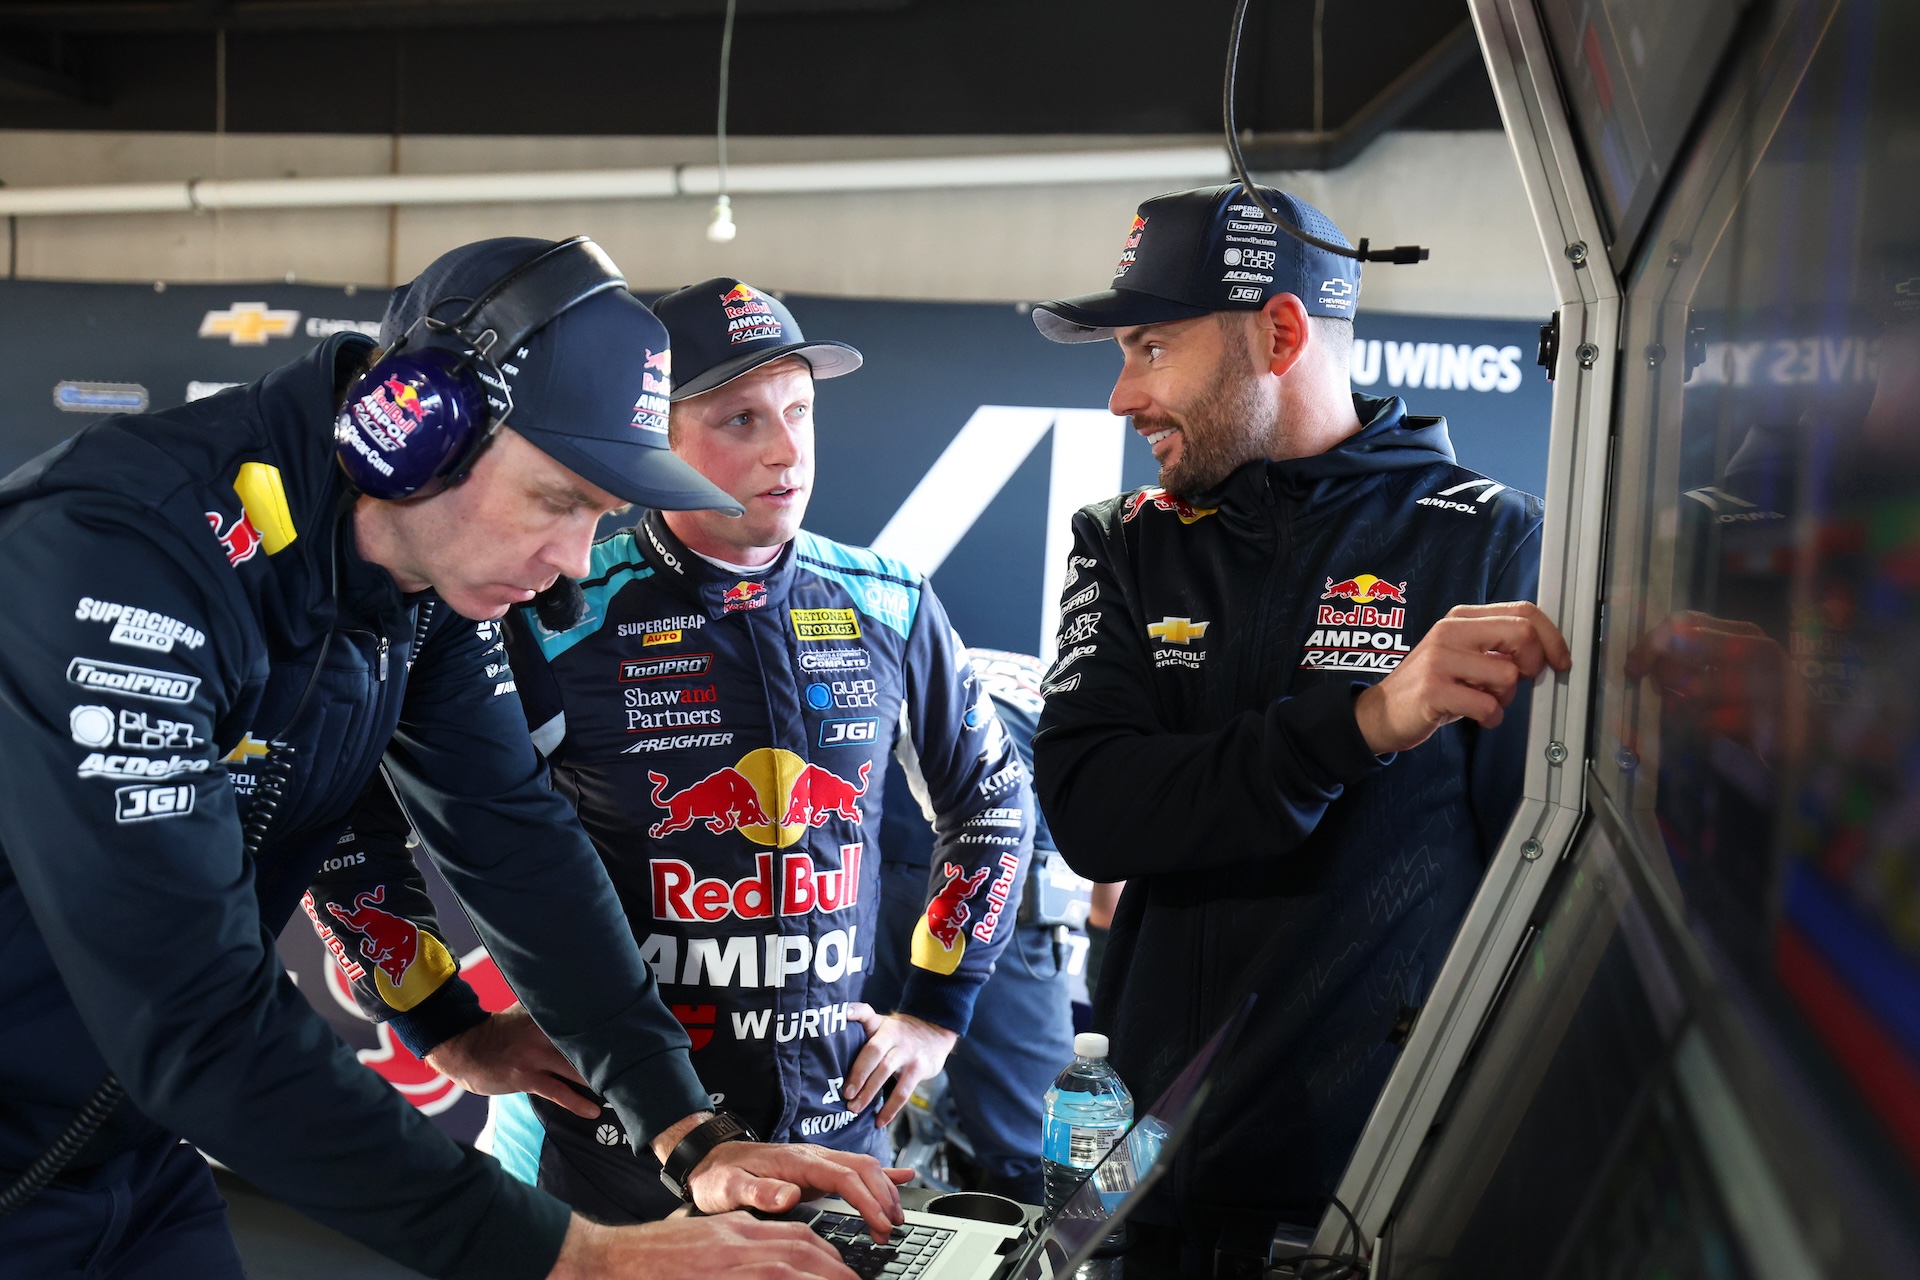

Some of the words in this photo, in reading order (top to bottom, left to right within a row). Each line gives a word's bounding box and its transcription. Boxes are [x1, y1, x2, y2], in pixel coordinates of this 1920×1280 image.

[1231, 222, 1273, 232] ToolPRO
[1242, 258, 1275, 270] LOCK
[1243, 249, 1276, 261] QUAD
[1224, 271, 1274, 283] ACDelco
[1232, 289, 1259, 300] JGI
[724, 303, 750, 320] Red
[750, 301, 773, 315] Bull
[728, 315, 781, 332] AMPOL
[731, 327, 781, 342] RACING
[1384, 340, 1523, 393] WINGS
[371, 385, 397, 414] Red
[388, 404, 418, 435] Bull
[353, 403, 400, 451] RACING
[361, 395, 407, 448] AMPOL
[1416, 497, 1478, 515] AMPOL
[75, 597, 205, 650] SUPERCHEAP
[617, 614, 707, 638] SUPERCHEAP
[794, 611, 852, 622] NATIONAL
[1316, 604, 1361, 626] Red
[1361, 606, 1405, 629] Bull
[119, 629, 167, 647] AUTO
[646, 632, 677, 645] AUTO
[800, 623, 854, 636] STORAGE
[1304, 630, 1411, 652] AMPOL
[1300, 650, 1405, 670] RACING
[75, 664, 189, 699] ToolPRO
[832, 679, 876, 695] QUAD
[834, 692, 878, 708] LOCK
[626, 707, 721, 730] Partners
[825, 723, 875, 743] JGI
[622, 733, 734, 754] FREIGHTER
[78, 752, 210, 777] ACDelco
[123, 785, 188, 818] JGI
[323, 852, 366, 872] tons
[650, 852, 775, 923] Red
[780, 842, 863, 917] Bull
[972, 899, 1005, 945] Red
[991, 851, 1020, 902] Bull
[300, 889, 333, 940] Red
[325, 937, 367, 982] Bull
[639, 925, 864, 988] AMPOL
[731, 1001, 848, 1042] WÜRTH
